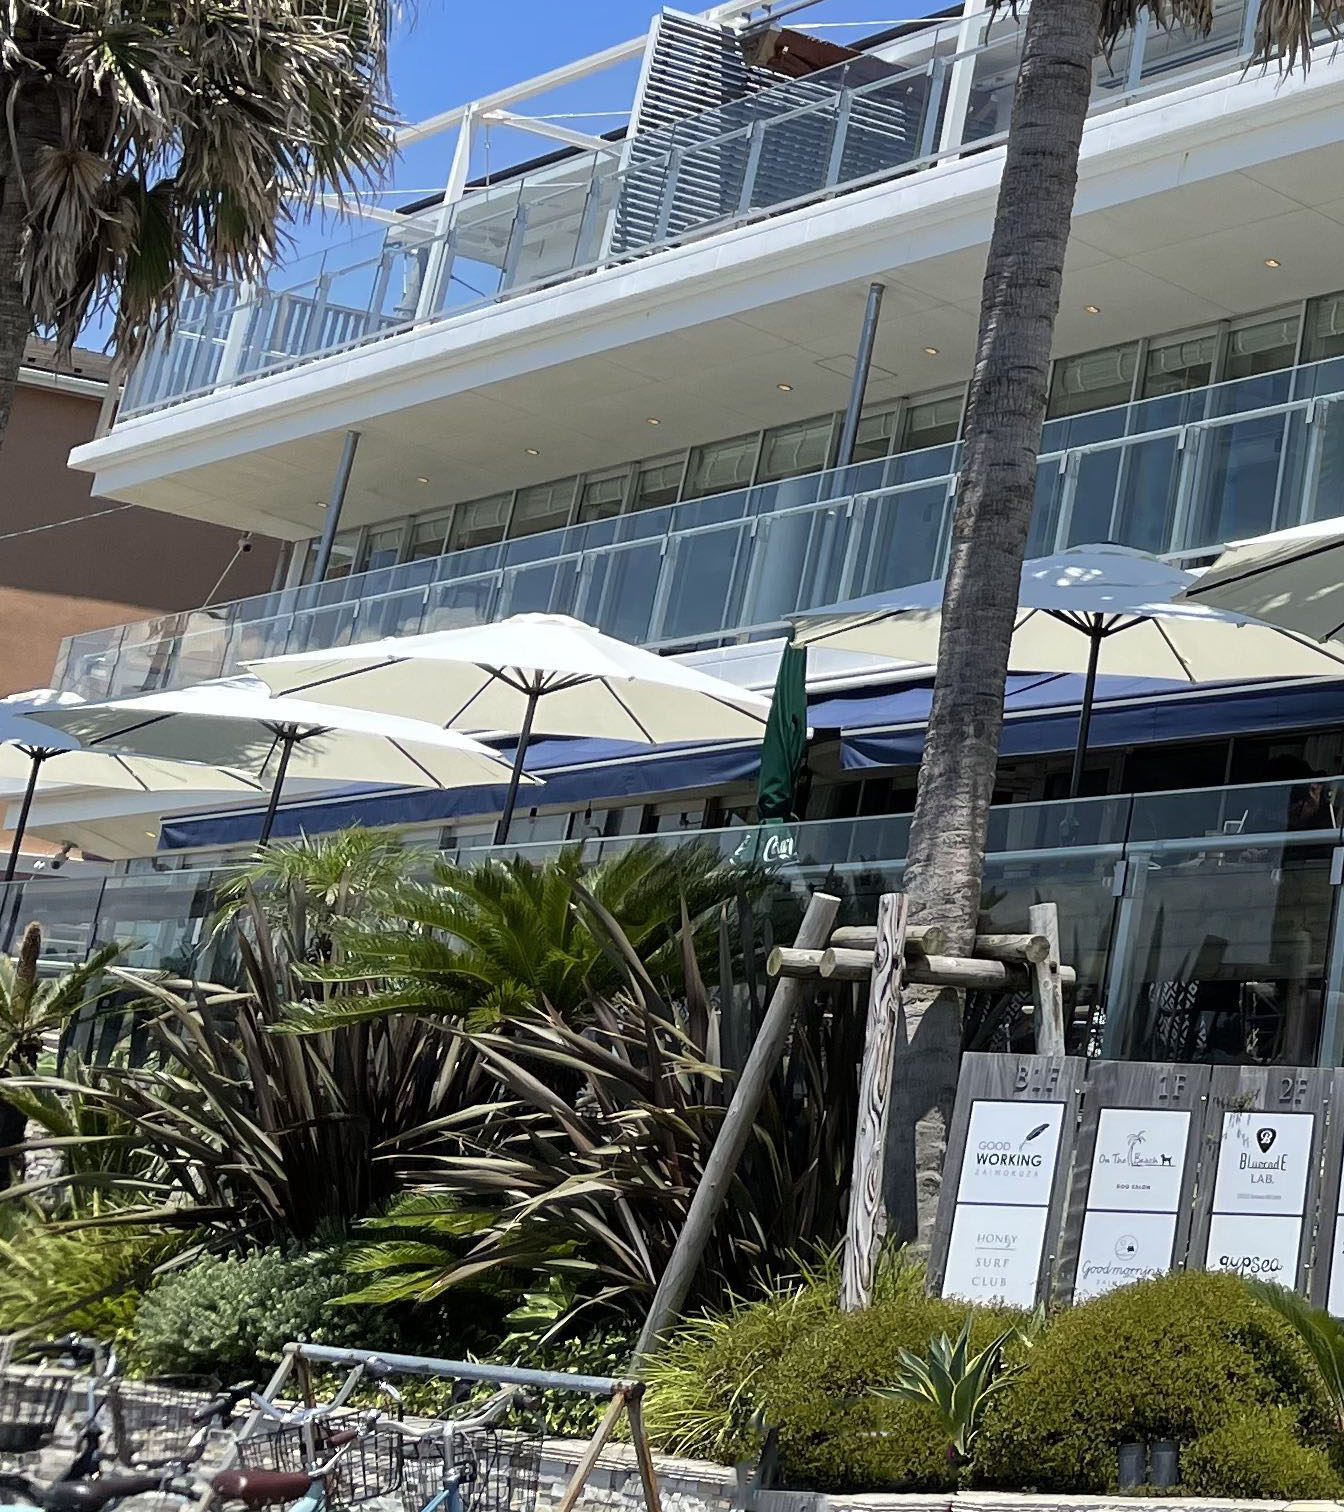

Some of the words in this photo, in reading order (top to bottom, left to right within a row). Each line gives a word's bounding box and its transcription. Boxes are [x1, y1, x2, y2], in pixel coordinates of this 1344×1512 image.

[1277, 1077, 1308, 1105] 2F
[978, 1141, 1011, 1151] GOOD
[976, 1152, 1042, 1167] WORKING
[1099, 1153, 1110, 1164] On
[1112, 1152, 1126, 1164] The
[975, 1257, 1011, 1268] SURF
[971, 1276, 1007, 1287] CLUB
